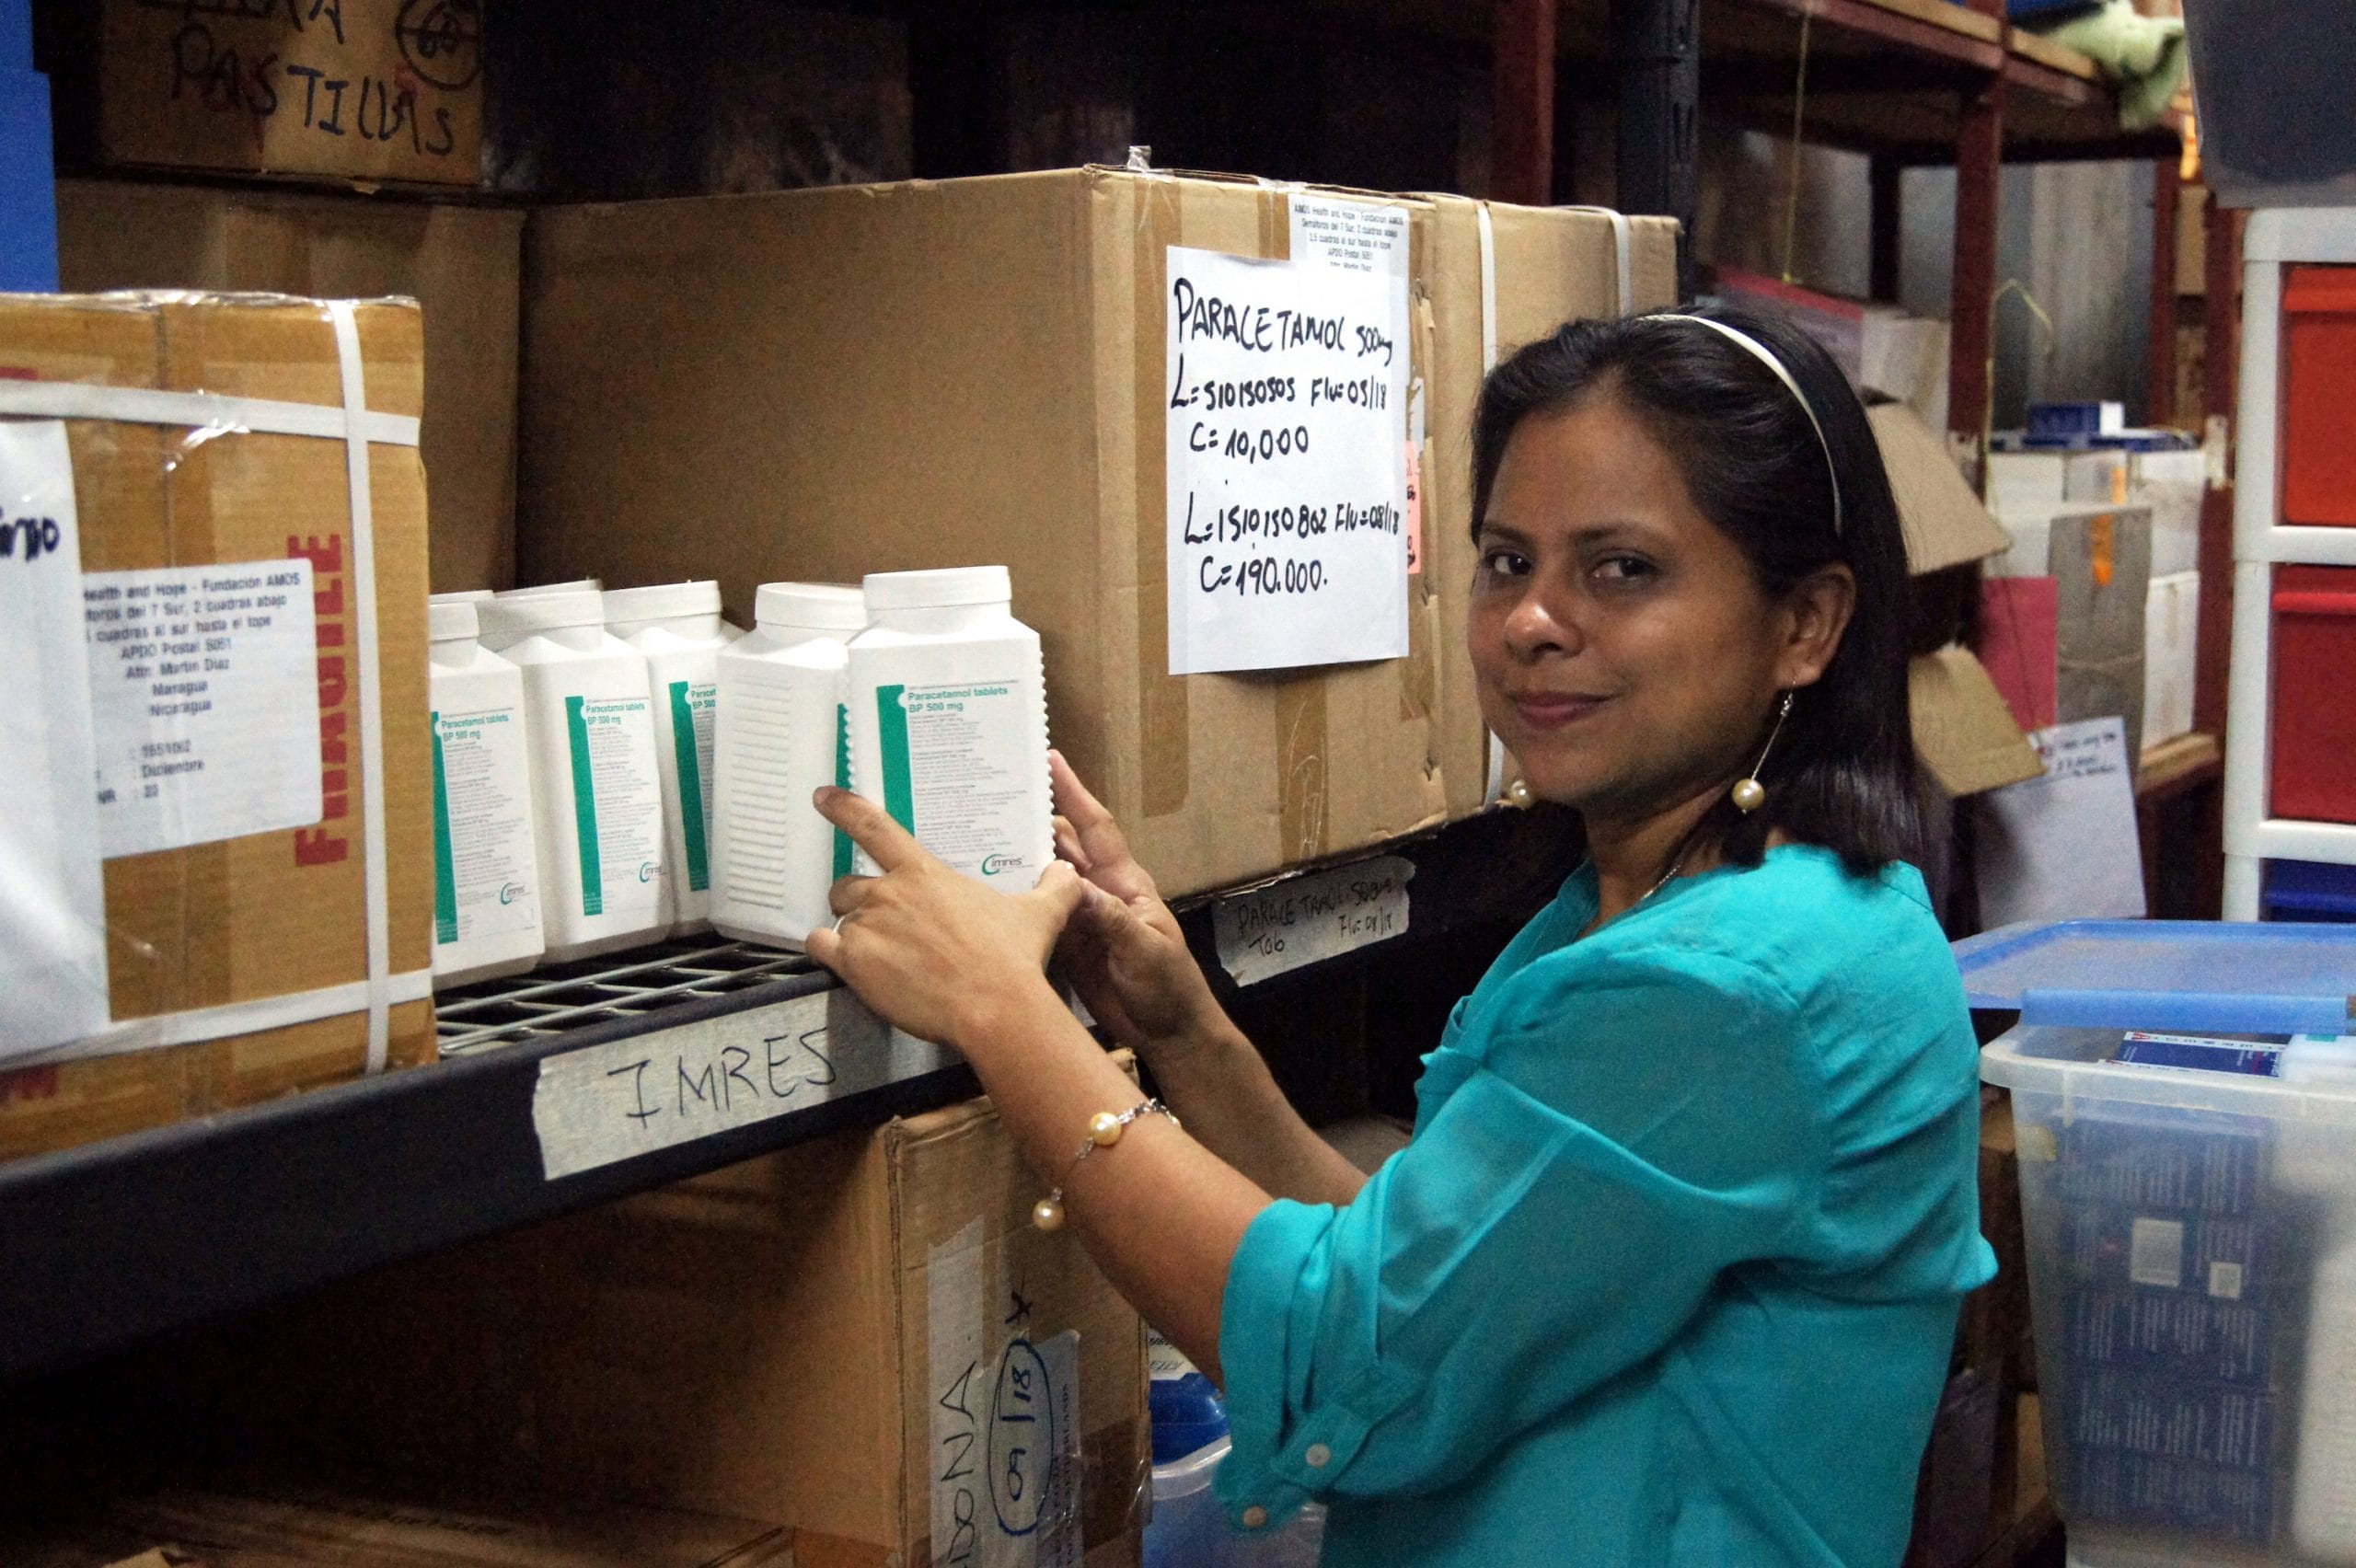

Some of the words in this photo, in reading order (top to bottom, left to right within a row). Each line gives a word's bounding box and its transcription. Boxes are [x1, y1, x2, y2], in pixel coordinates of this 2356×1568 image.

[1174, 277, 1345, 352] PARACETAMOL
[267, 571, 301, 587] AMOS
[153, 681, 209, 697] Managua
[907, 690, 971, 701] Paracetamol
[973, 686, 1008, 698] tablets
[151, 700, 213, 717] Nicaragua
[908, 703, 923, 713] BP
[926, 702, 944, 711] 500
[947, 702, 964, 712] mg
[606, 1026, 837, 1129] IMRES
